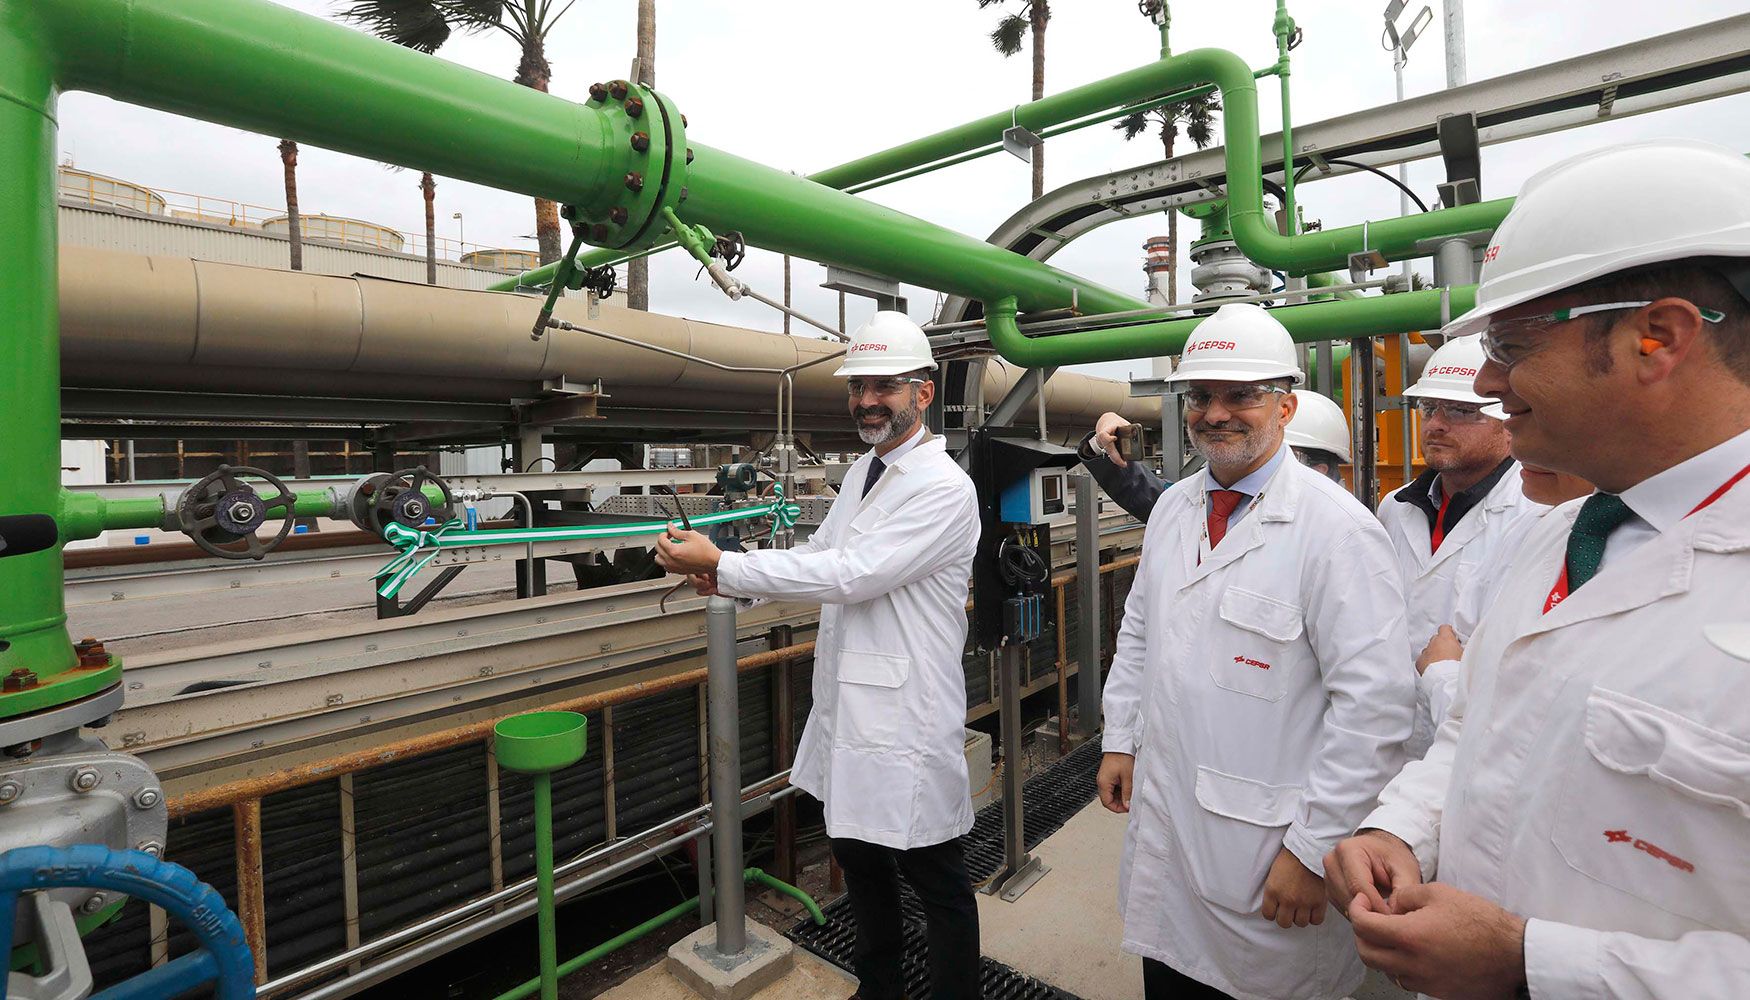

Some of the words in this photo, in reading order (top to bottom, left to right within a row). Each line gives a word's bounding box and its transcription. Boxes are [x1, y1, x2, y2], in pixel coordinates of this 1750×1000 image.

[859, 343, 888, 352] CEPSA
[1198, 341, 1236, 351] CEPSA
[1438, 366, 1477, 377] CEPSA
[1245, 659, 1270, 670] CEPSA
[192, 903, 226, 937] SHUT
